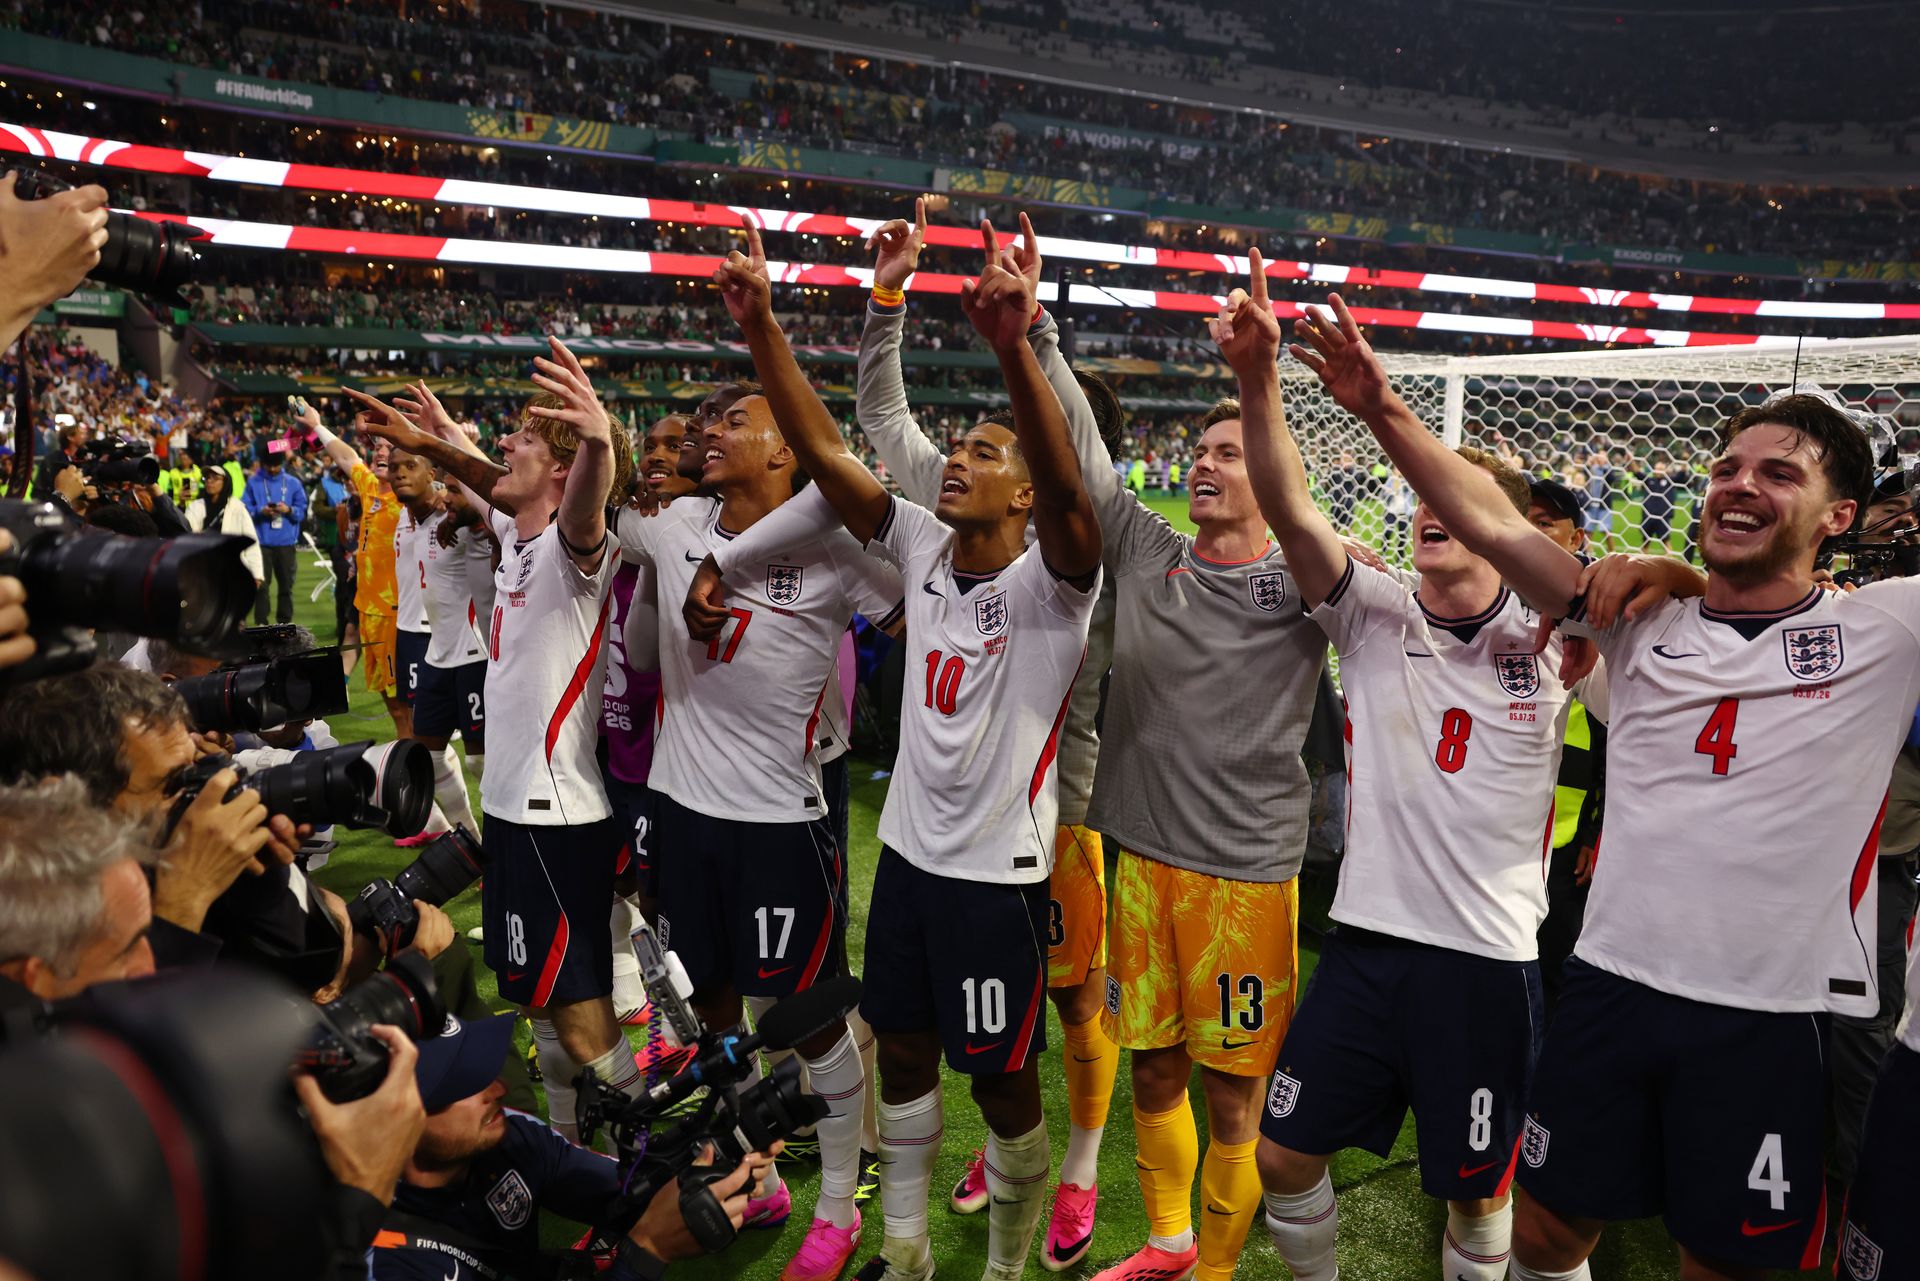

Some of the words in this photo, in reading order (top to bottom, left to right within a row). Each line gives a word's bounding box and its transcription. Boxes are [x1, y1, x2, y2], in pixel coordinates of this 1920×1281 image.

[215, 79, 313, 110] #FIFAWorldCup
[983, 636, 1008, 648] MEXICO
[409, 663, 418, 690] 5
[925, 649, 965, 716] 10
[467, 692, 484, 721] 2
[604, 711, 632, 731] 26
[612, 701, 630, 714] CUP
[1508, 702, 1537, 711] MEXICO
[1509, 712, 1537, 722] 05.07.26
[1435, 707, 1473, 774] 8
[1695, 696, 1740, 776] 4
[505, 910, 527, 966] 18
[754, 906, 795, 959] 17
[962, 977, 1007, 1034] 10
[1216, 972, 1264, 1033] 13
[1469, 1087, 1493, 1151] 8
[1748, 1133, 1791, 1211] 4
[416, 1238, 438, 1250] FIFA
[439, 1243, 466, 1261] WORLD
[465, 1255, 479, 1268] CUP
